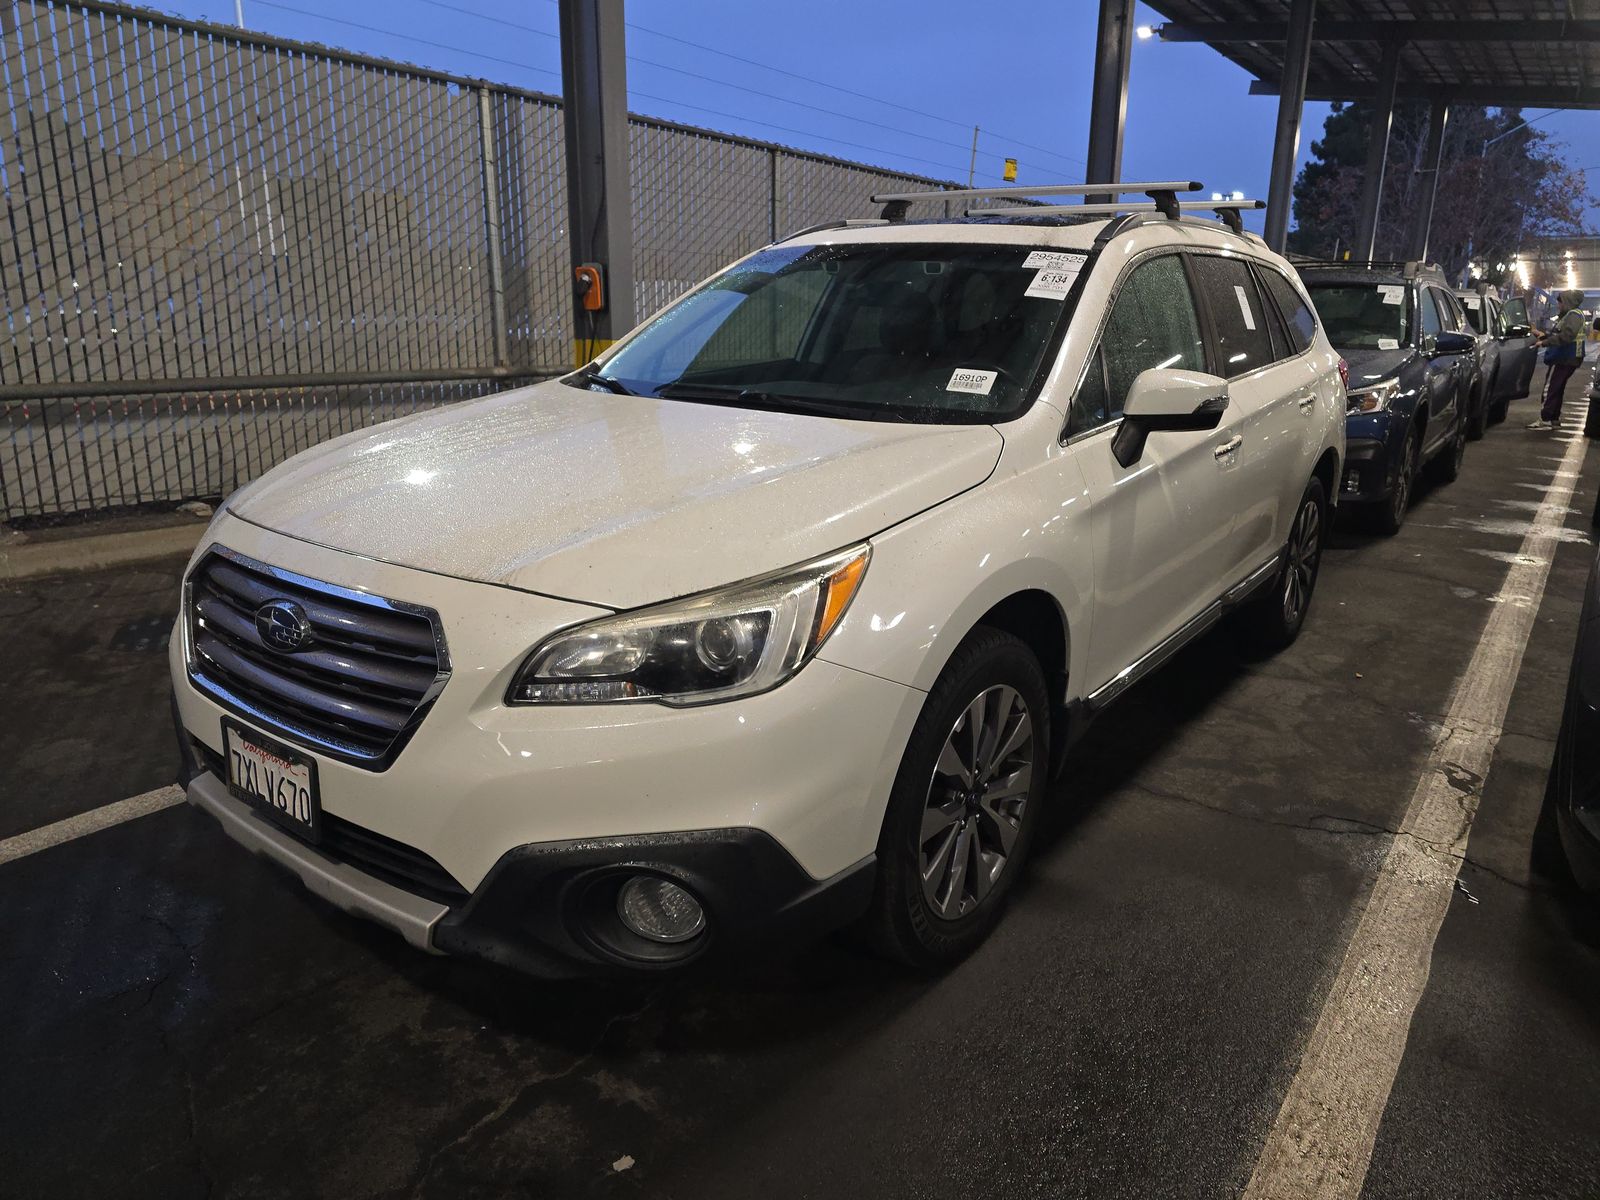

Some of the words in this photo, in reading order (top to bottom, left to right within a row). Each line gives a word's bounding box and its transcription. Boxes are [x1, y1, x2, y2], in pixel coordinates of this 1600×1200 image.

[1030, 252, 1085, 263] 2954525
[953, 373, 988, 383] 16910P
[232, 749, 311, 825] 7XLV670
